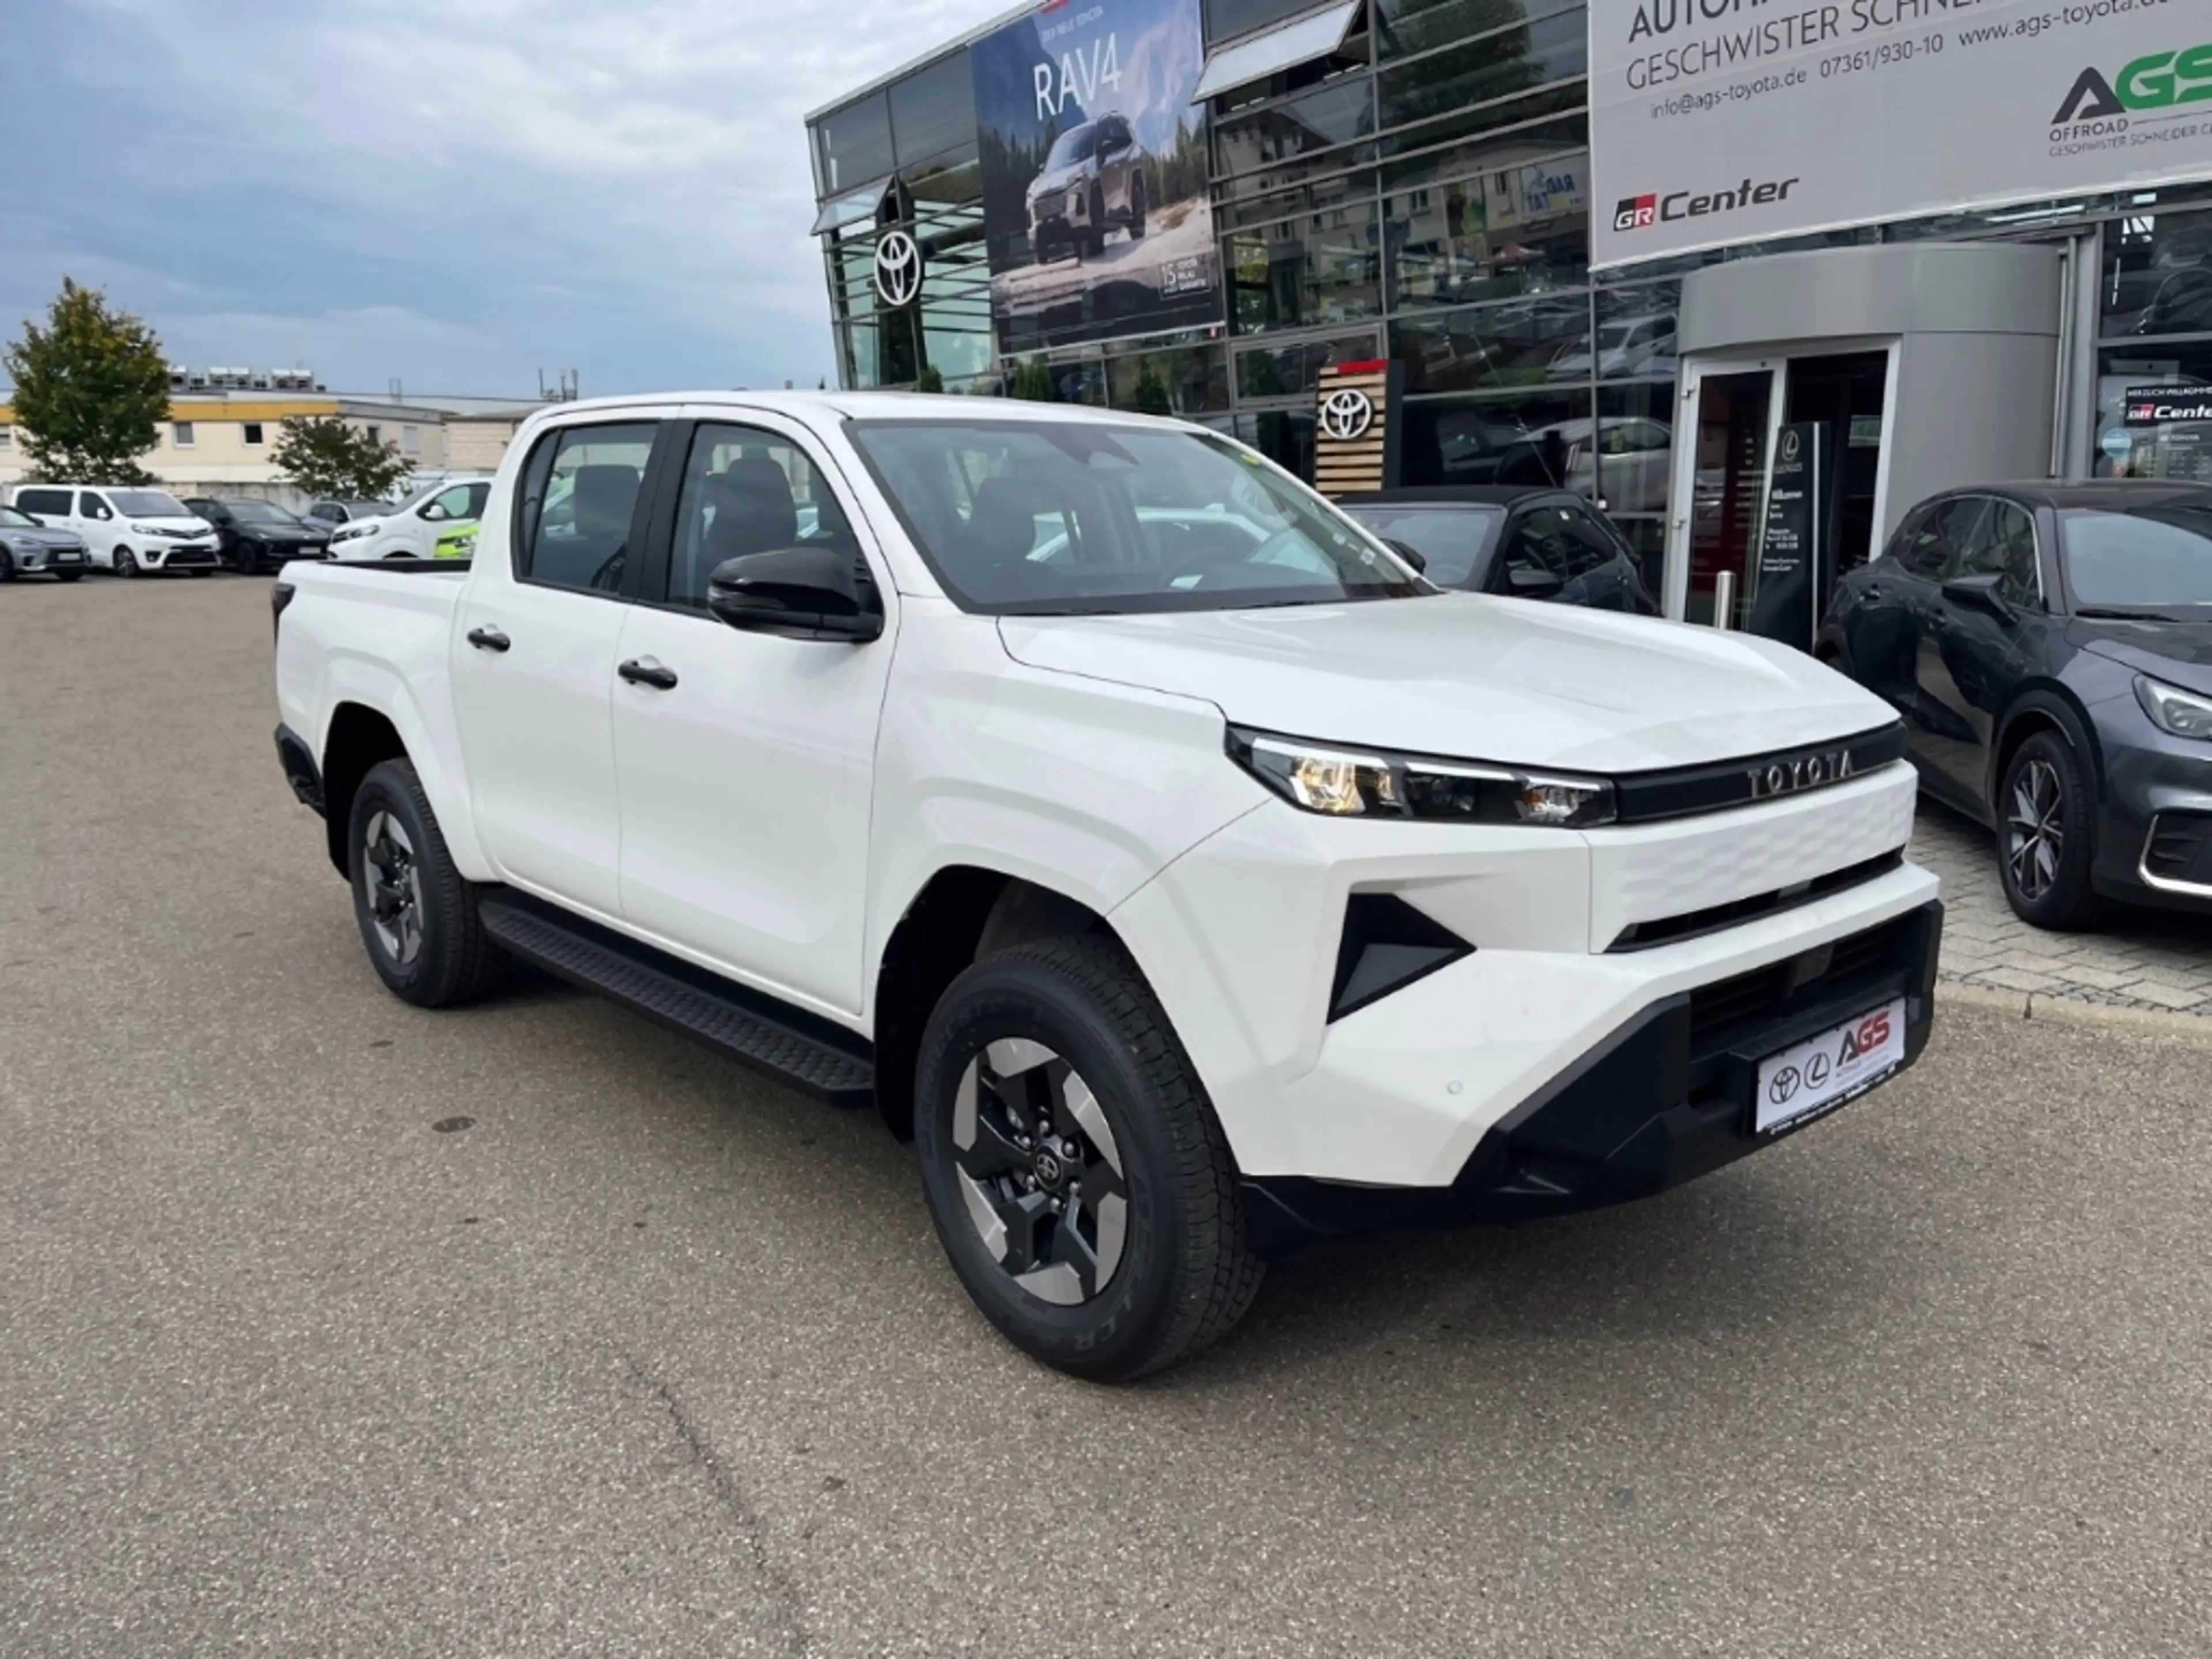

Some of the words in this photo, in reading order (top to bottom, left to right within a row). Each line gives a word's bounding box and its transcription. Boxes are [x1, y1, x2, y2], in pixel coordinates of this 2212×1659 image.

[1627, 6, 1839, 89] GESCHWISTER
[1651, 67, 1807, 119] info@ags-toyota.de
[1820, 33, 1944, 78] 07361/930-10
[1033, 32, 1122, 121] RAV4
[2051, 43, 2212, 126] AGS
[2049, 135, 2126, 157] GESCHWISTER
[2130, 123, 2198, 146] SCHNEIDER
[2050, 119, 2129, 142] OFFROAD
[1615, 206, 1655, 229] GR
[1660, 177, 1800, 221] Center
[1748, 749, 1855, 798] TOYOTA
[1836, 1010, 1890, 1067] AGS
